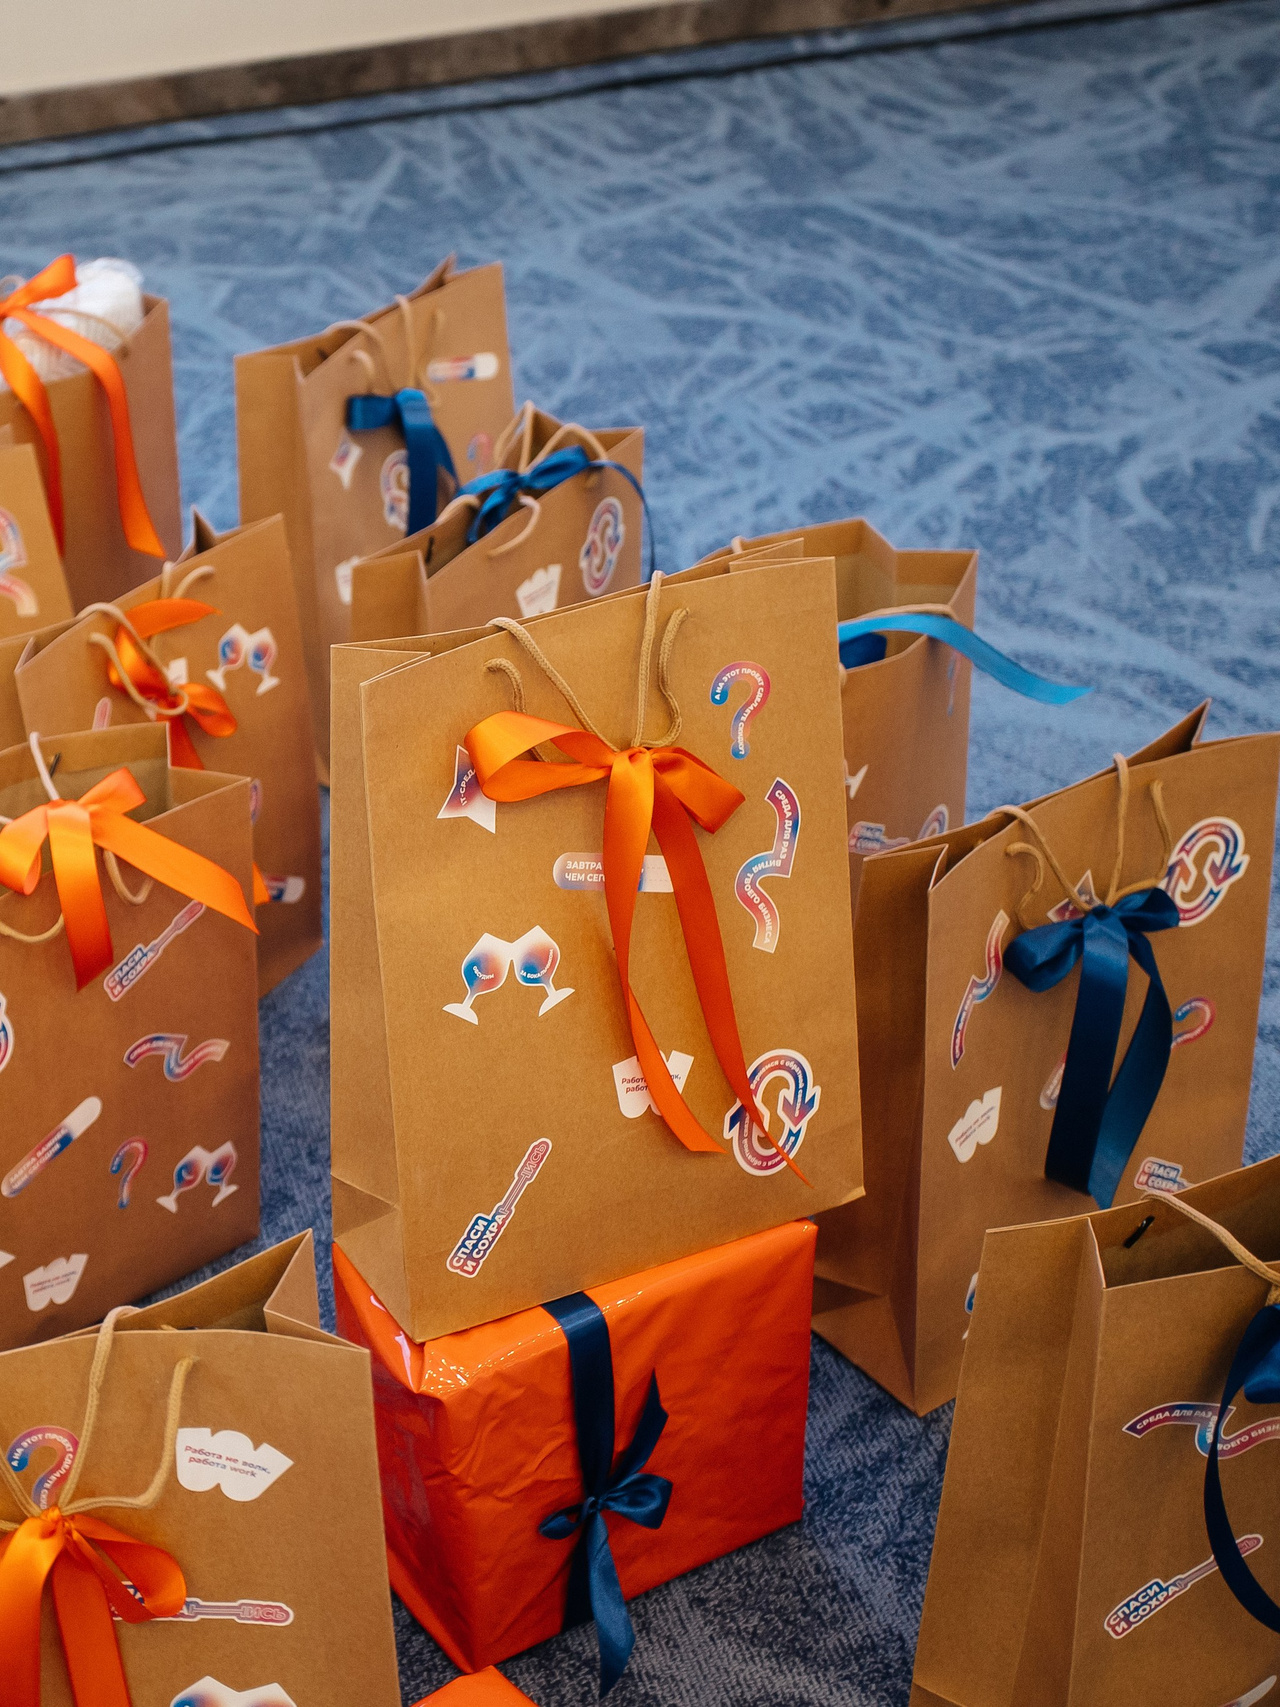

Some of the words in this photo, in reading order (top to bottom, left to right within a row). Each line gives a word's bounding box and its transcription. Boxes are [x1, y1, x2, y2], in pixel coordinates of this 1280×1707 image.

[715, 682, 725, 694] НА
[722, 668, 740, 683] ЭТОТ
[741, 667, 764, 686] ПРОЕКТ
[459, 768, 476, 807] IT-СРЕД
[774, 789, 792, 819] СРЕДА
[784, 819, 793, 841] ДЛЯ
[566, 860, 602, 871] ЗАВТРА
[565, 872, 587, 882] ЧЕМ
[744, 872, 761, 904] ТВОЕГО
[758, 903, 773, 945] БИЗНЕСА
[622, 1077, 646, 1085] Работ
[626, 1085, 648, 1095] работ
[1143, 1161, 1178, 1179] СПАСИ
[453, 1219, 488, 1267] СПАСИ
[464, 1261, 477, 1273] И
[1136, 1411, 1170, 1430] СРЕДА
[1171, 1409, 1193, 1417] ДЛЯ
[1217, 1435, 1250, 1451] ВОЕГО
[13, 1447, 25, 1460] НА
[184, 1445, 223, 1460] Работа
[225, 1455, 239, 1464] не
[242, 1460, 271, 1475] волк,
[188, 1456, 227, 1470] работа
[229, 1466, 258, 1478] work
[1109, 1584, 1160, 1626] СПАСИ
[1115, 1621, 1128, 1634] И
